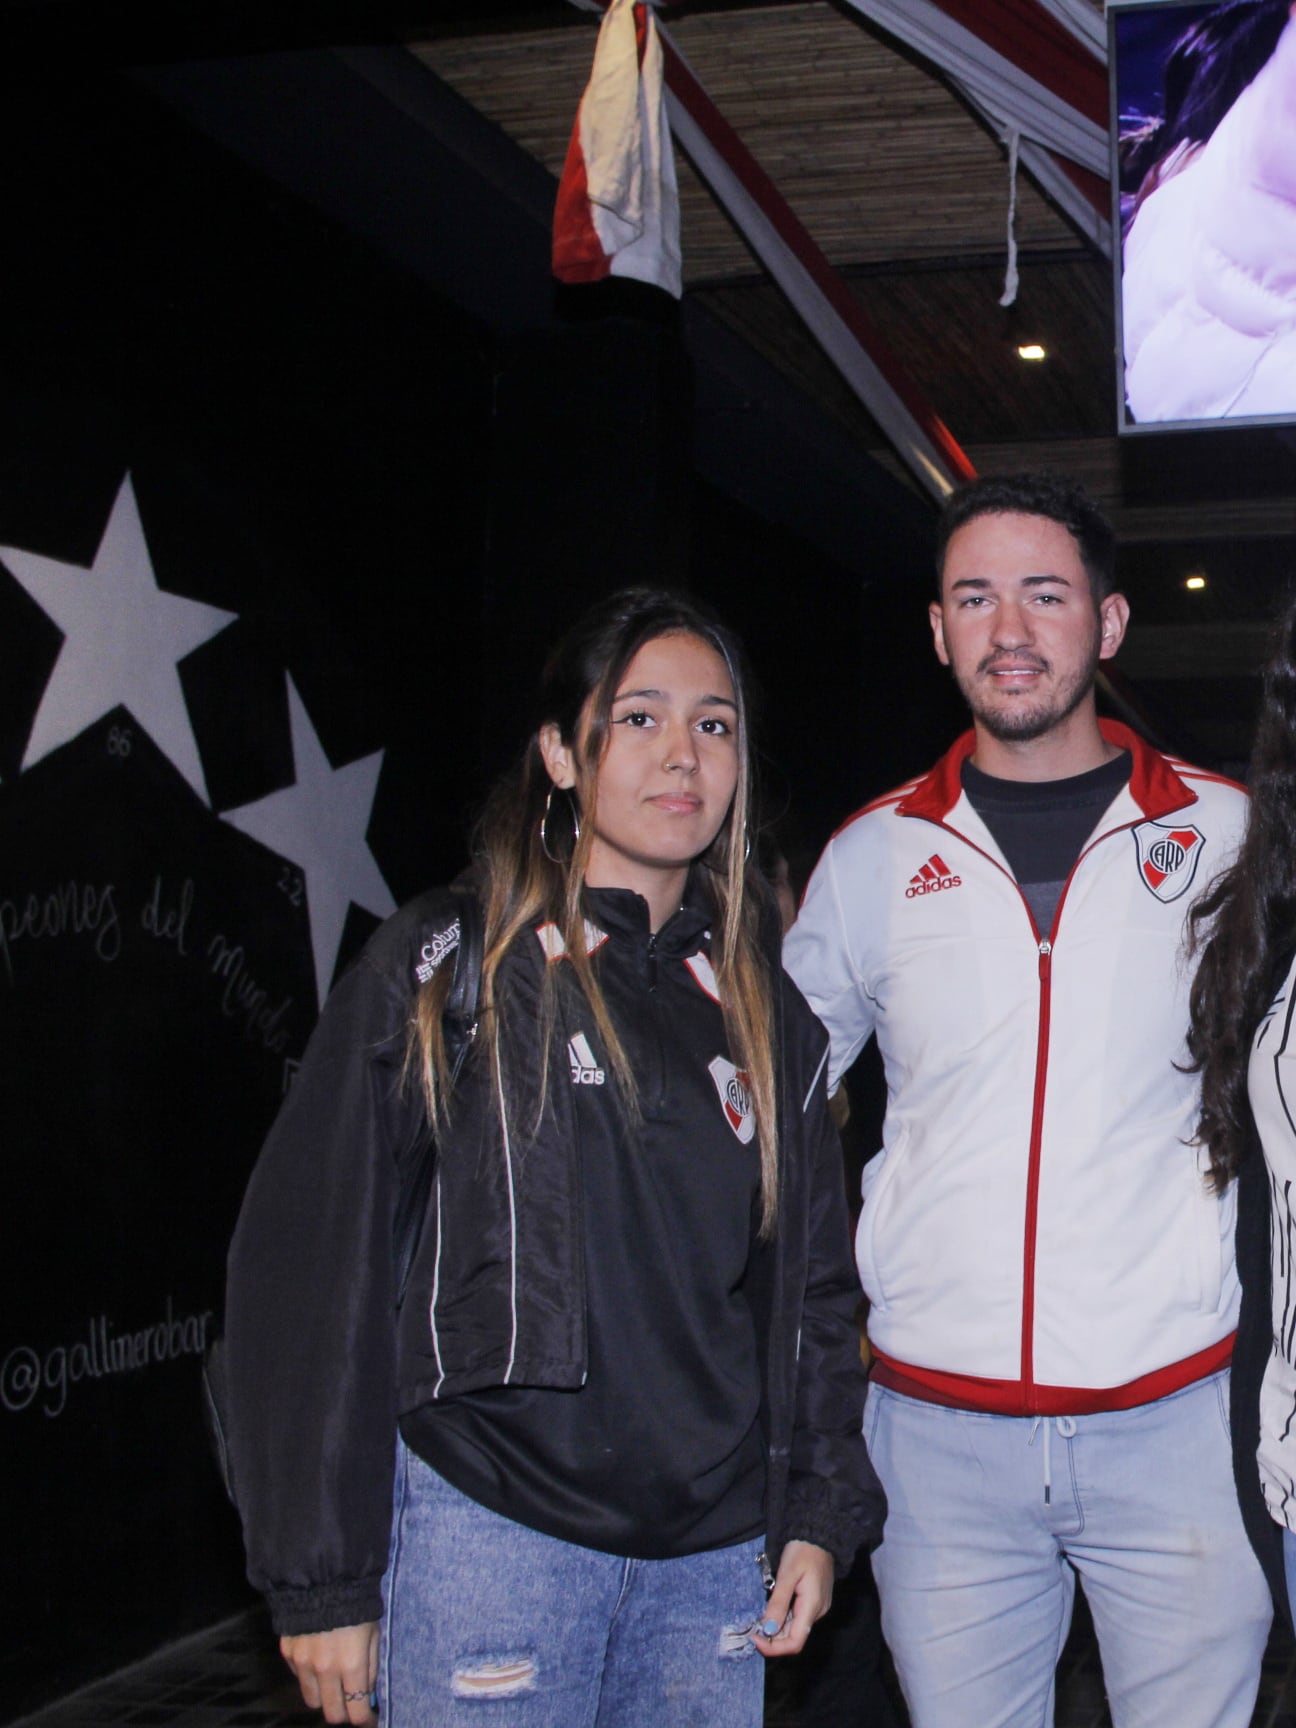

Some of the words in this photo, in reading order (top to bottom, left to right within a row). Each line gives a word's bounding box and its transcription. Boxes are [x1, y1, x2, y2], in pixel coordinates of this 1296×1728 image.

[1149, 840, 1185, 873] CARP
[277, 867, 304, 907] 22
[905, 875, 962, 899] adidas
[141, 874, 194, 957] del
[421, 917, 461, 962] Colum
[0, 1295, 214, 1419] @gallinerobar
